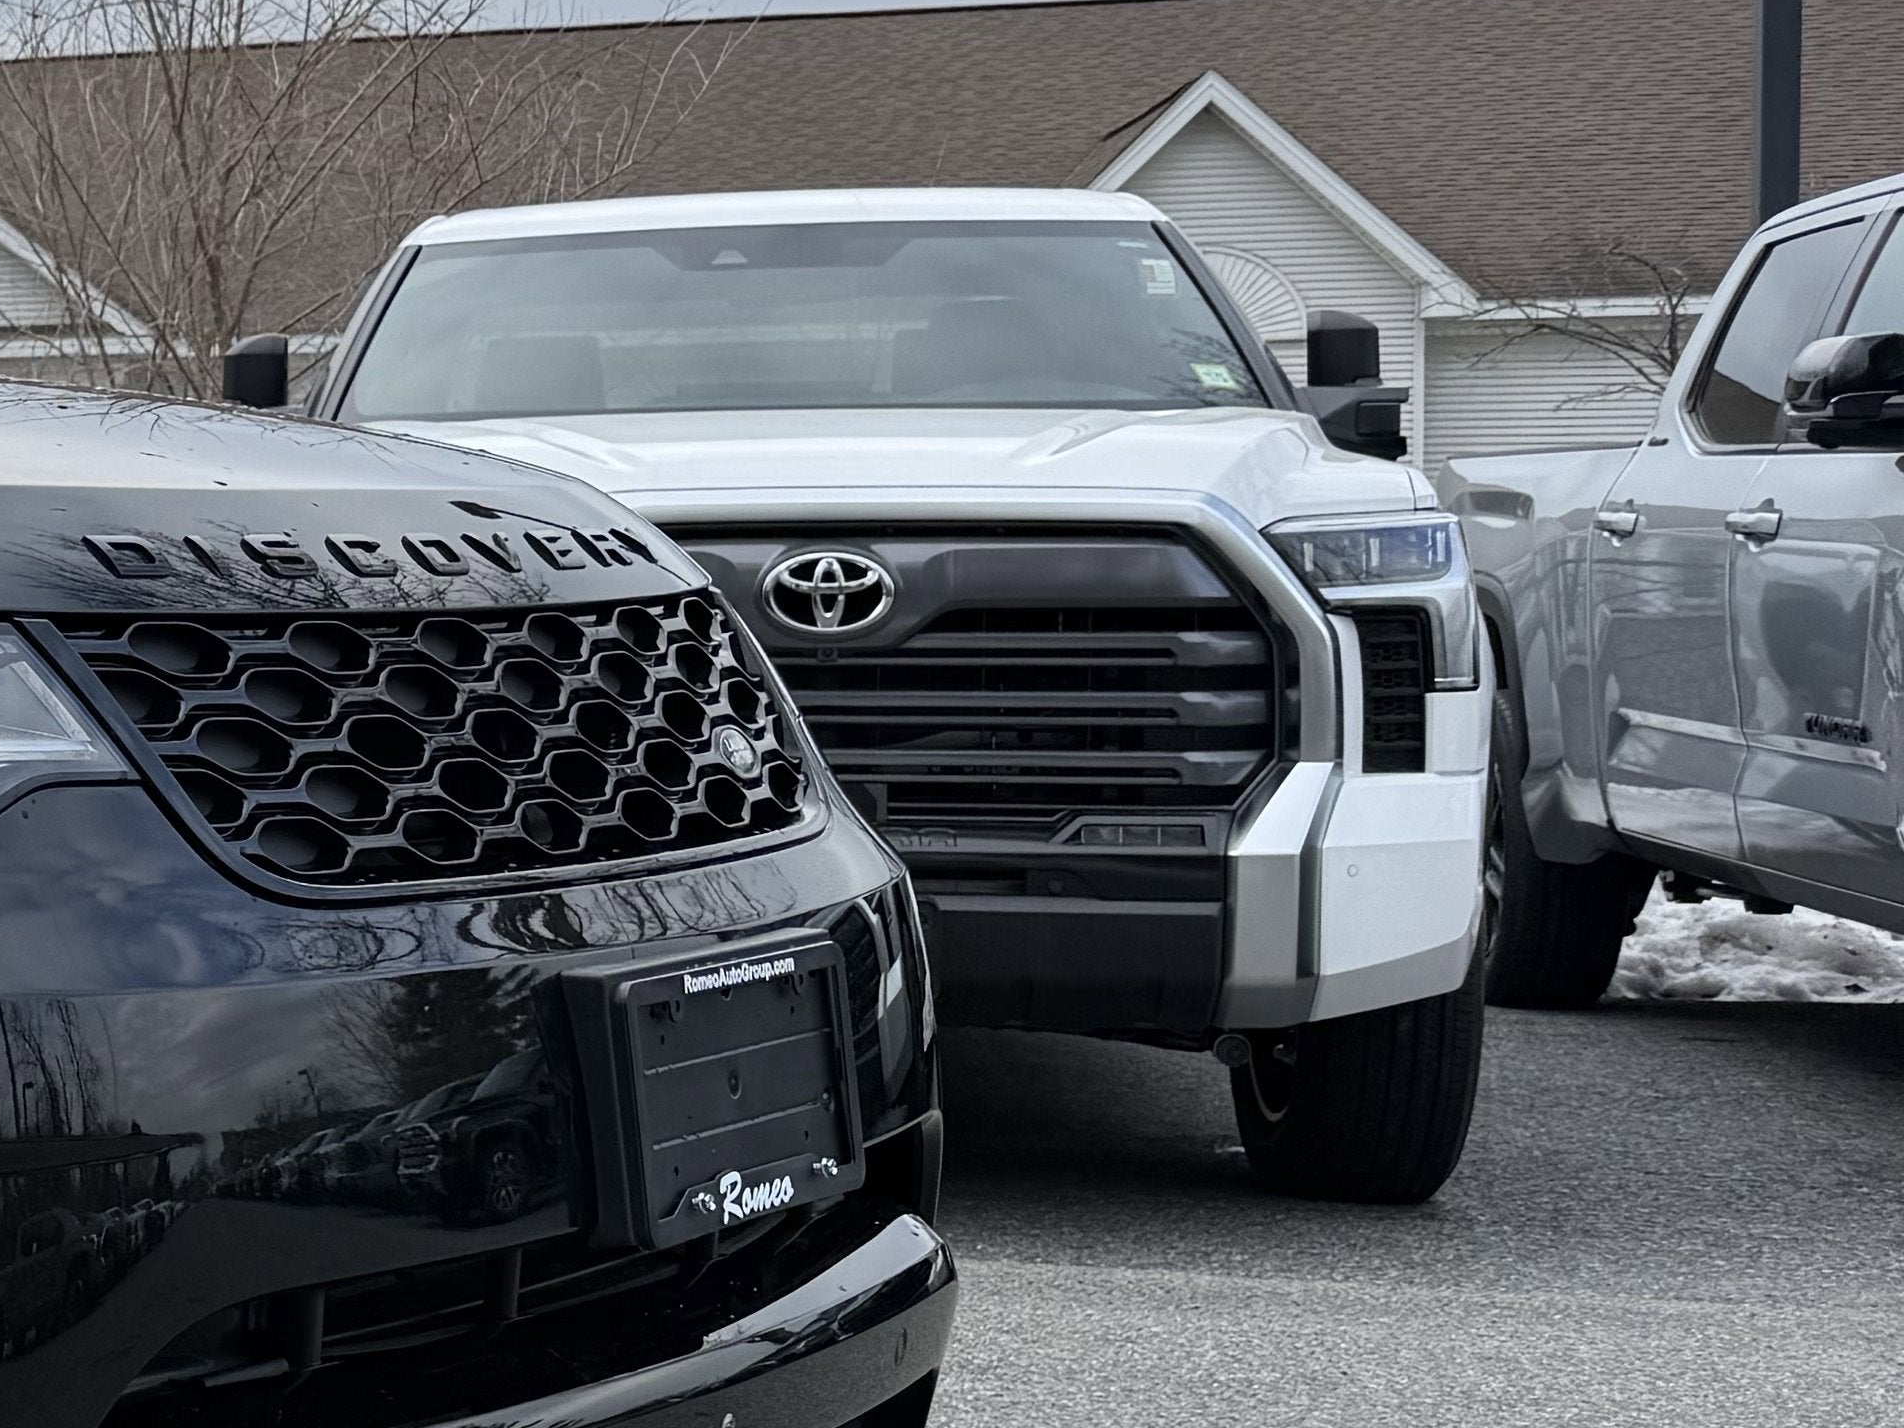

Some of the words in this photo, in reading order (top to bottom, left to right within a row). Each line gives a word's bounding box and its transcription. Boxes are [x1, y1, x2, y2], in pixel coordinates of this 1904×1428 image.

[80, 527, 659, 579] DISCOVERY
[684, 956, 795, 995] RomeoAutoGroup.com
[719, 1170, 795, 1225] Romeo
